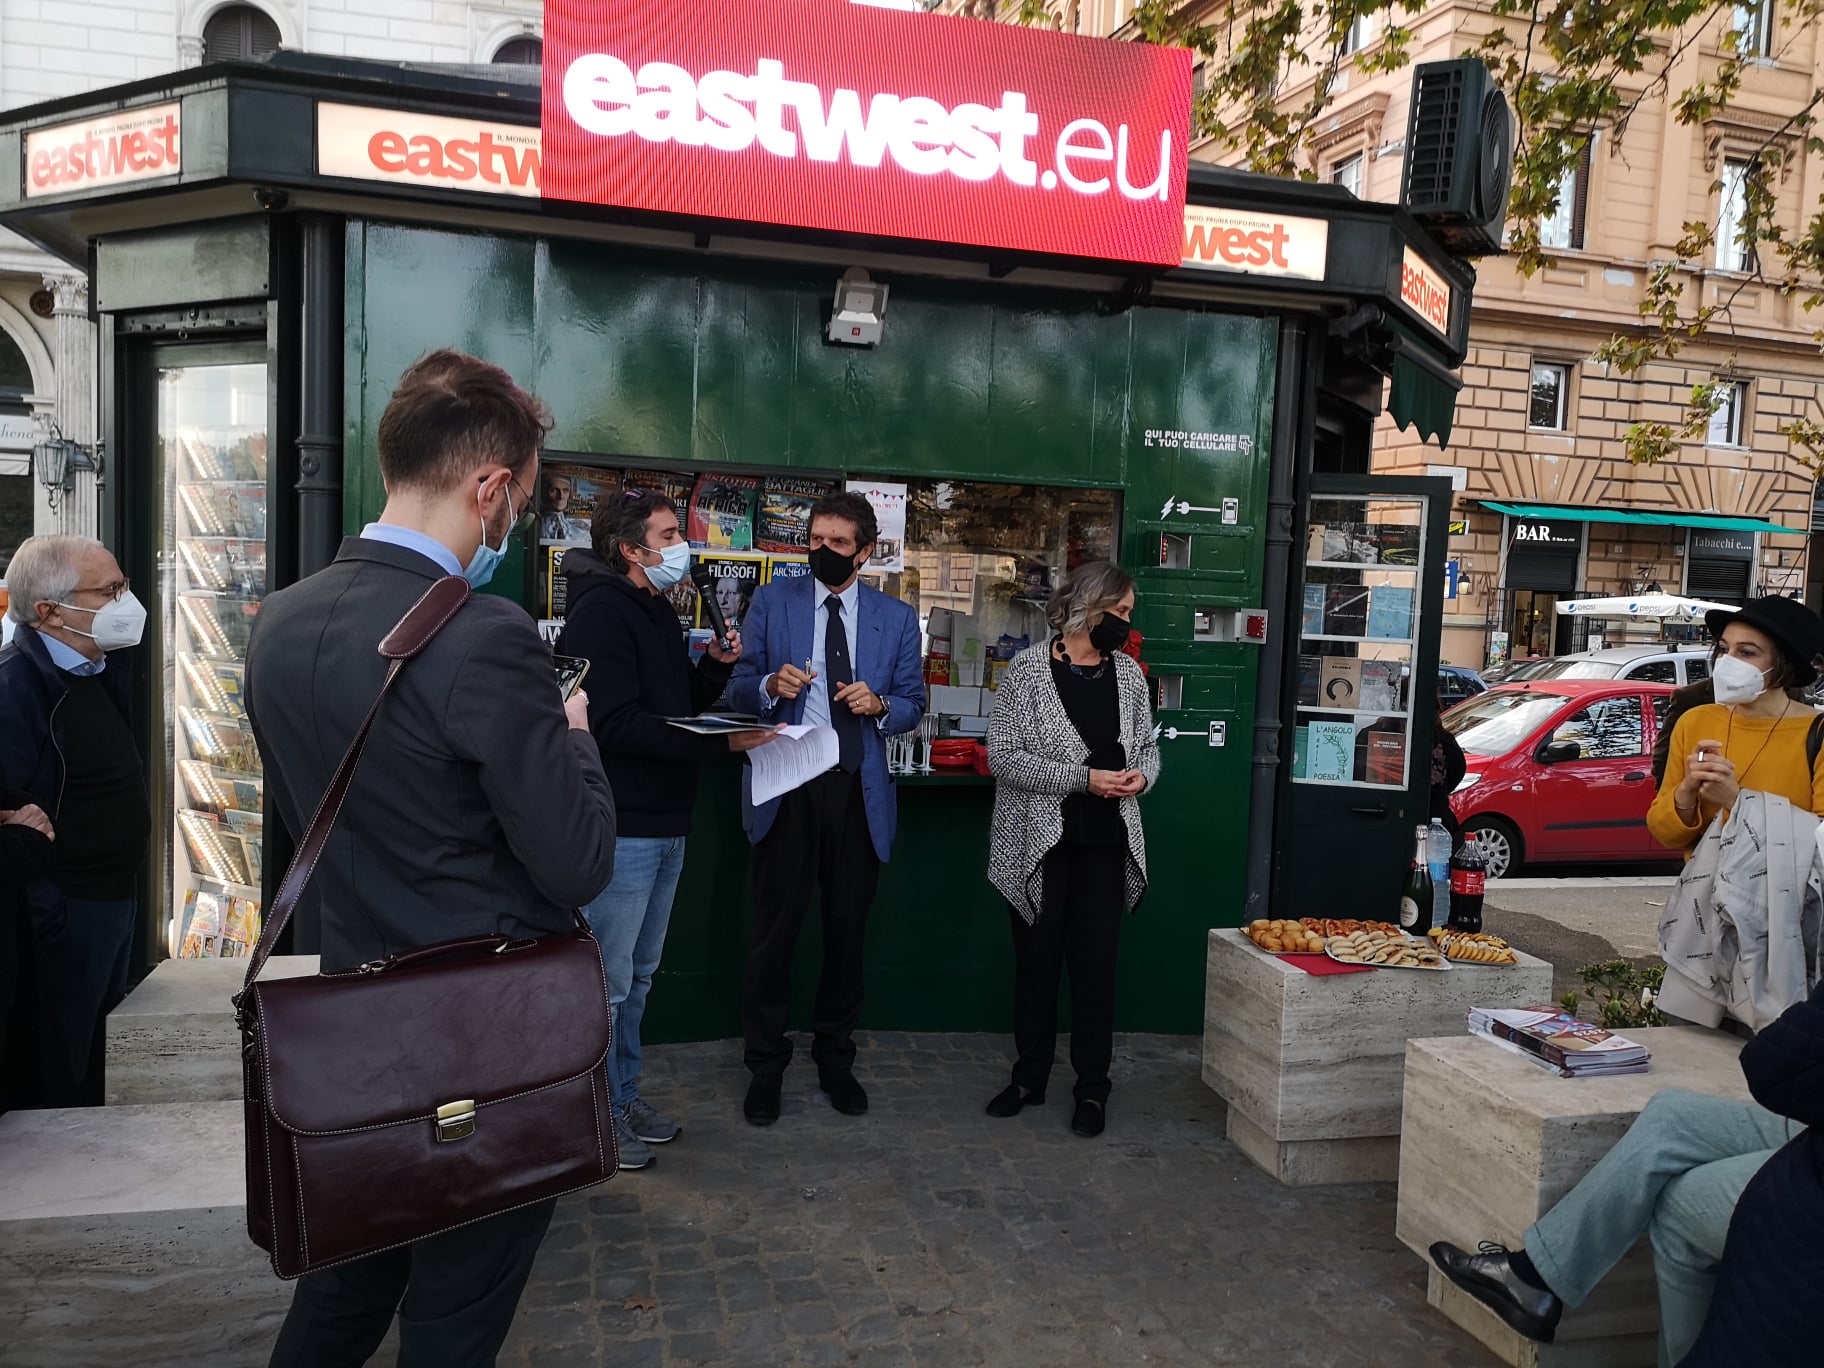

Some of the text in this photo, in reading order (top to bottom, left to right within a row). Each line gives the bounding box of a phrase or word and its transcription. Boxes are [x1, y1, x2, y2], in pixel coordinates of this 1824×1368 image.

[563, 52, 1171, 201] eastwest.eu
[32, 114, 178, 188] eastwest
[1402, 262, 1447, 329] eastwest
[1144, 429, 1237, 443] QUI PUOI CARICARE
[1144, 438, 1237, 451] IL TUO CELLULARE
[765, 481, 828, 497] BATTAGLIE
[779, 477, 817, 489] GRANDI
[1515, 524, 1550, 541] BAR
[1695, 536, 1735, 549] Tabacchi
[708, 564, 757, 579] FILOSOFI
[1639, 604, 1661, 614] pepsi
[1316, 725, 1353, 735] L'ANGOLO
[1313, 773, 1340, 781] POESIA
